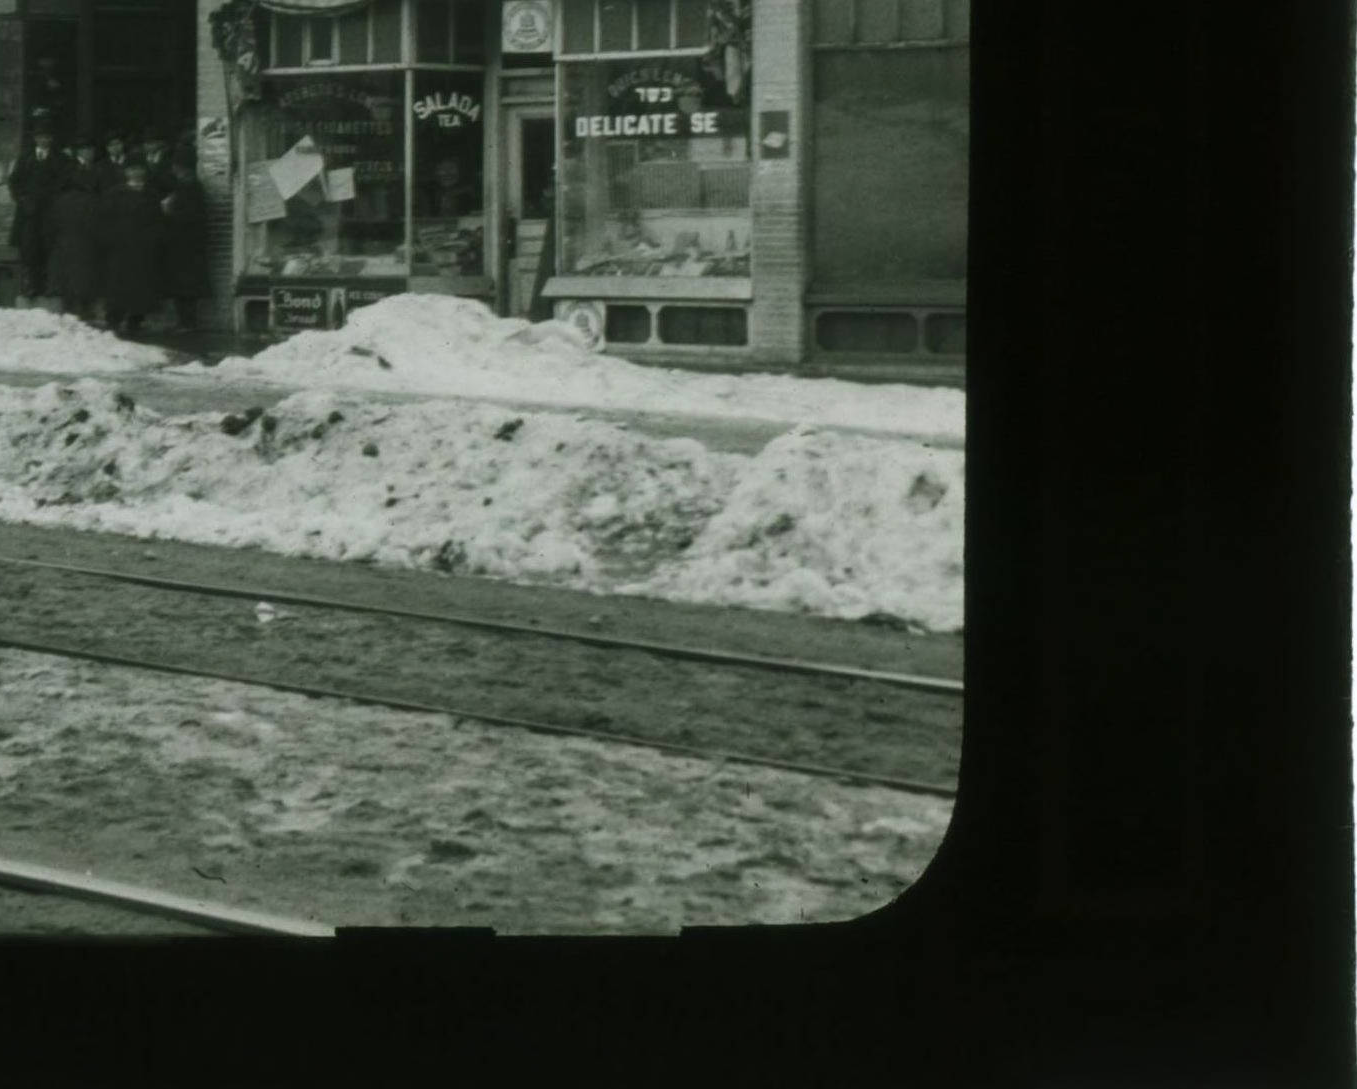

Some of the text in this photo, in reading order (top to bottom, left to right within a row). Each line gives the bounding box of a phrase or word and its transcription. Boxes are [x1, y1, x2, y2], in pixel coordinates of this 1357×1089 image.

[412, 91, 481, 123] SALADA
[437, 114, 461, 127] TEA
[575, 112, 719, 138] DELICATE SE
